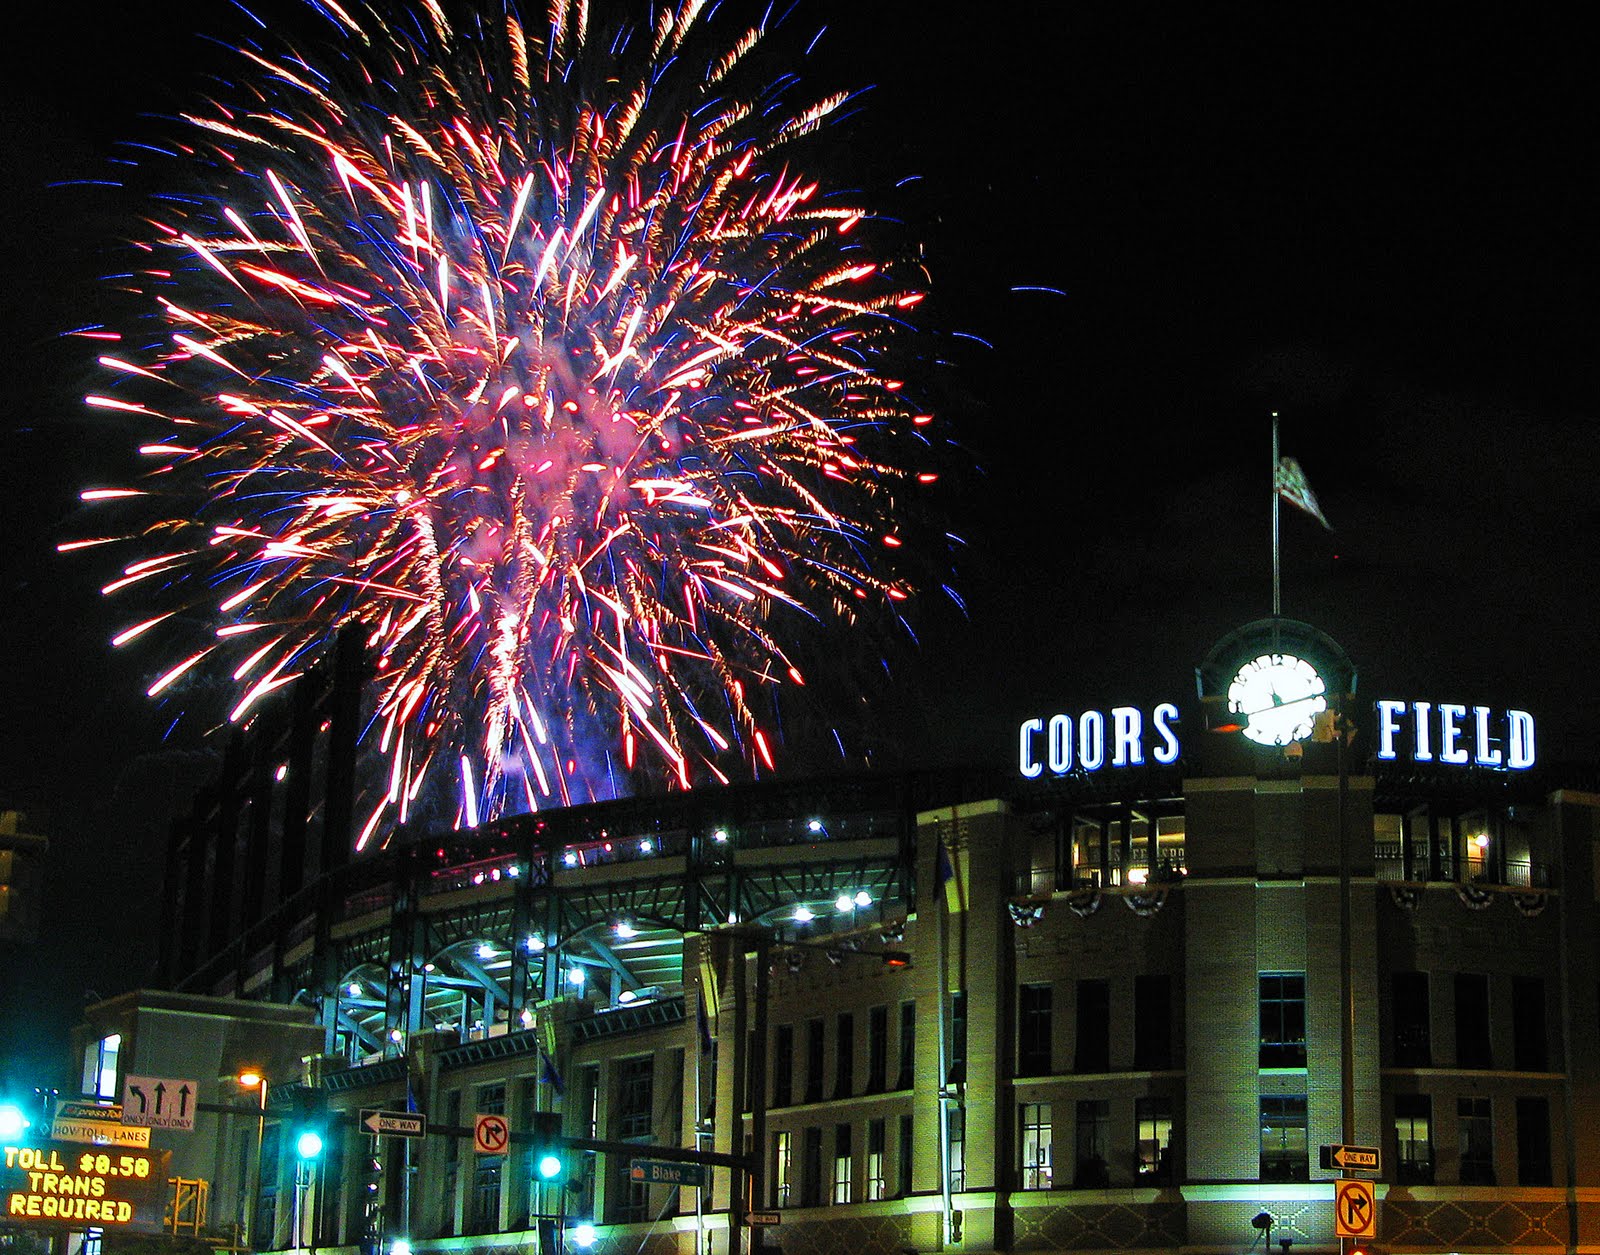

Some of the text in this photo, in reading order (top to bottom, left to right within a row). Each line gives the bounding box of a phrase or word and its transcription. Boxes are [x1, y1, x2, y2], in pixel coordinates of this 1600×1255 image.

[1019, 703, 1180, 780] COORS
[1377, 700, 1536, 771] FIELD
[124, 1114, 145, 1124] ONLY
[149, 1117, 168, 1126] ONLY
[171, 1119, 192, 1128] ONLY
[380, 1119, 417, 1130] ONE WAY
[54, 1126, 76, 1136] HOV
[114, 1131, 147, 1142] LANES
[4, 1147, 149, 1178] TOLL $0.50
[1344, 1153, 1374, 1164] ONE WAY
[653, 1166, 681, 1181] Blake
[29, 1172, 105, 1197] TRANS
[10, 1194, 132, 1222] REQUIRED
